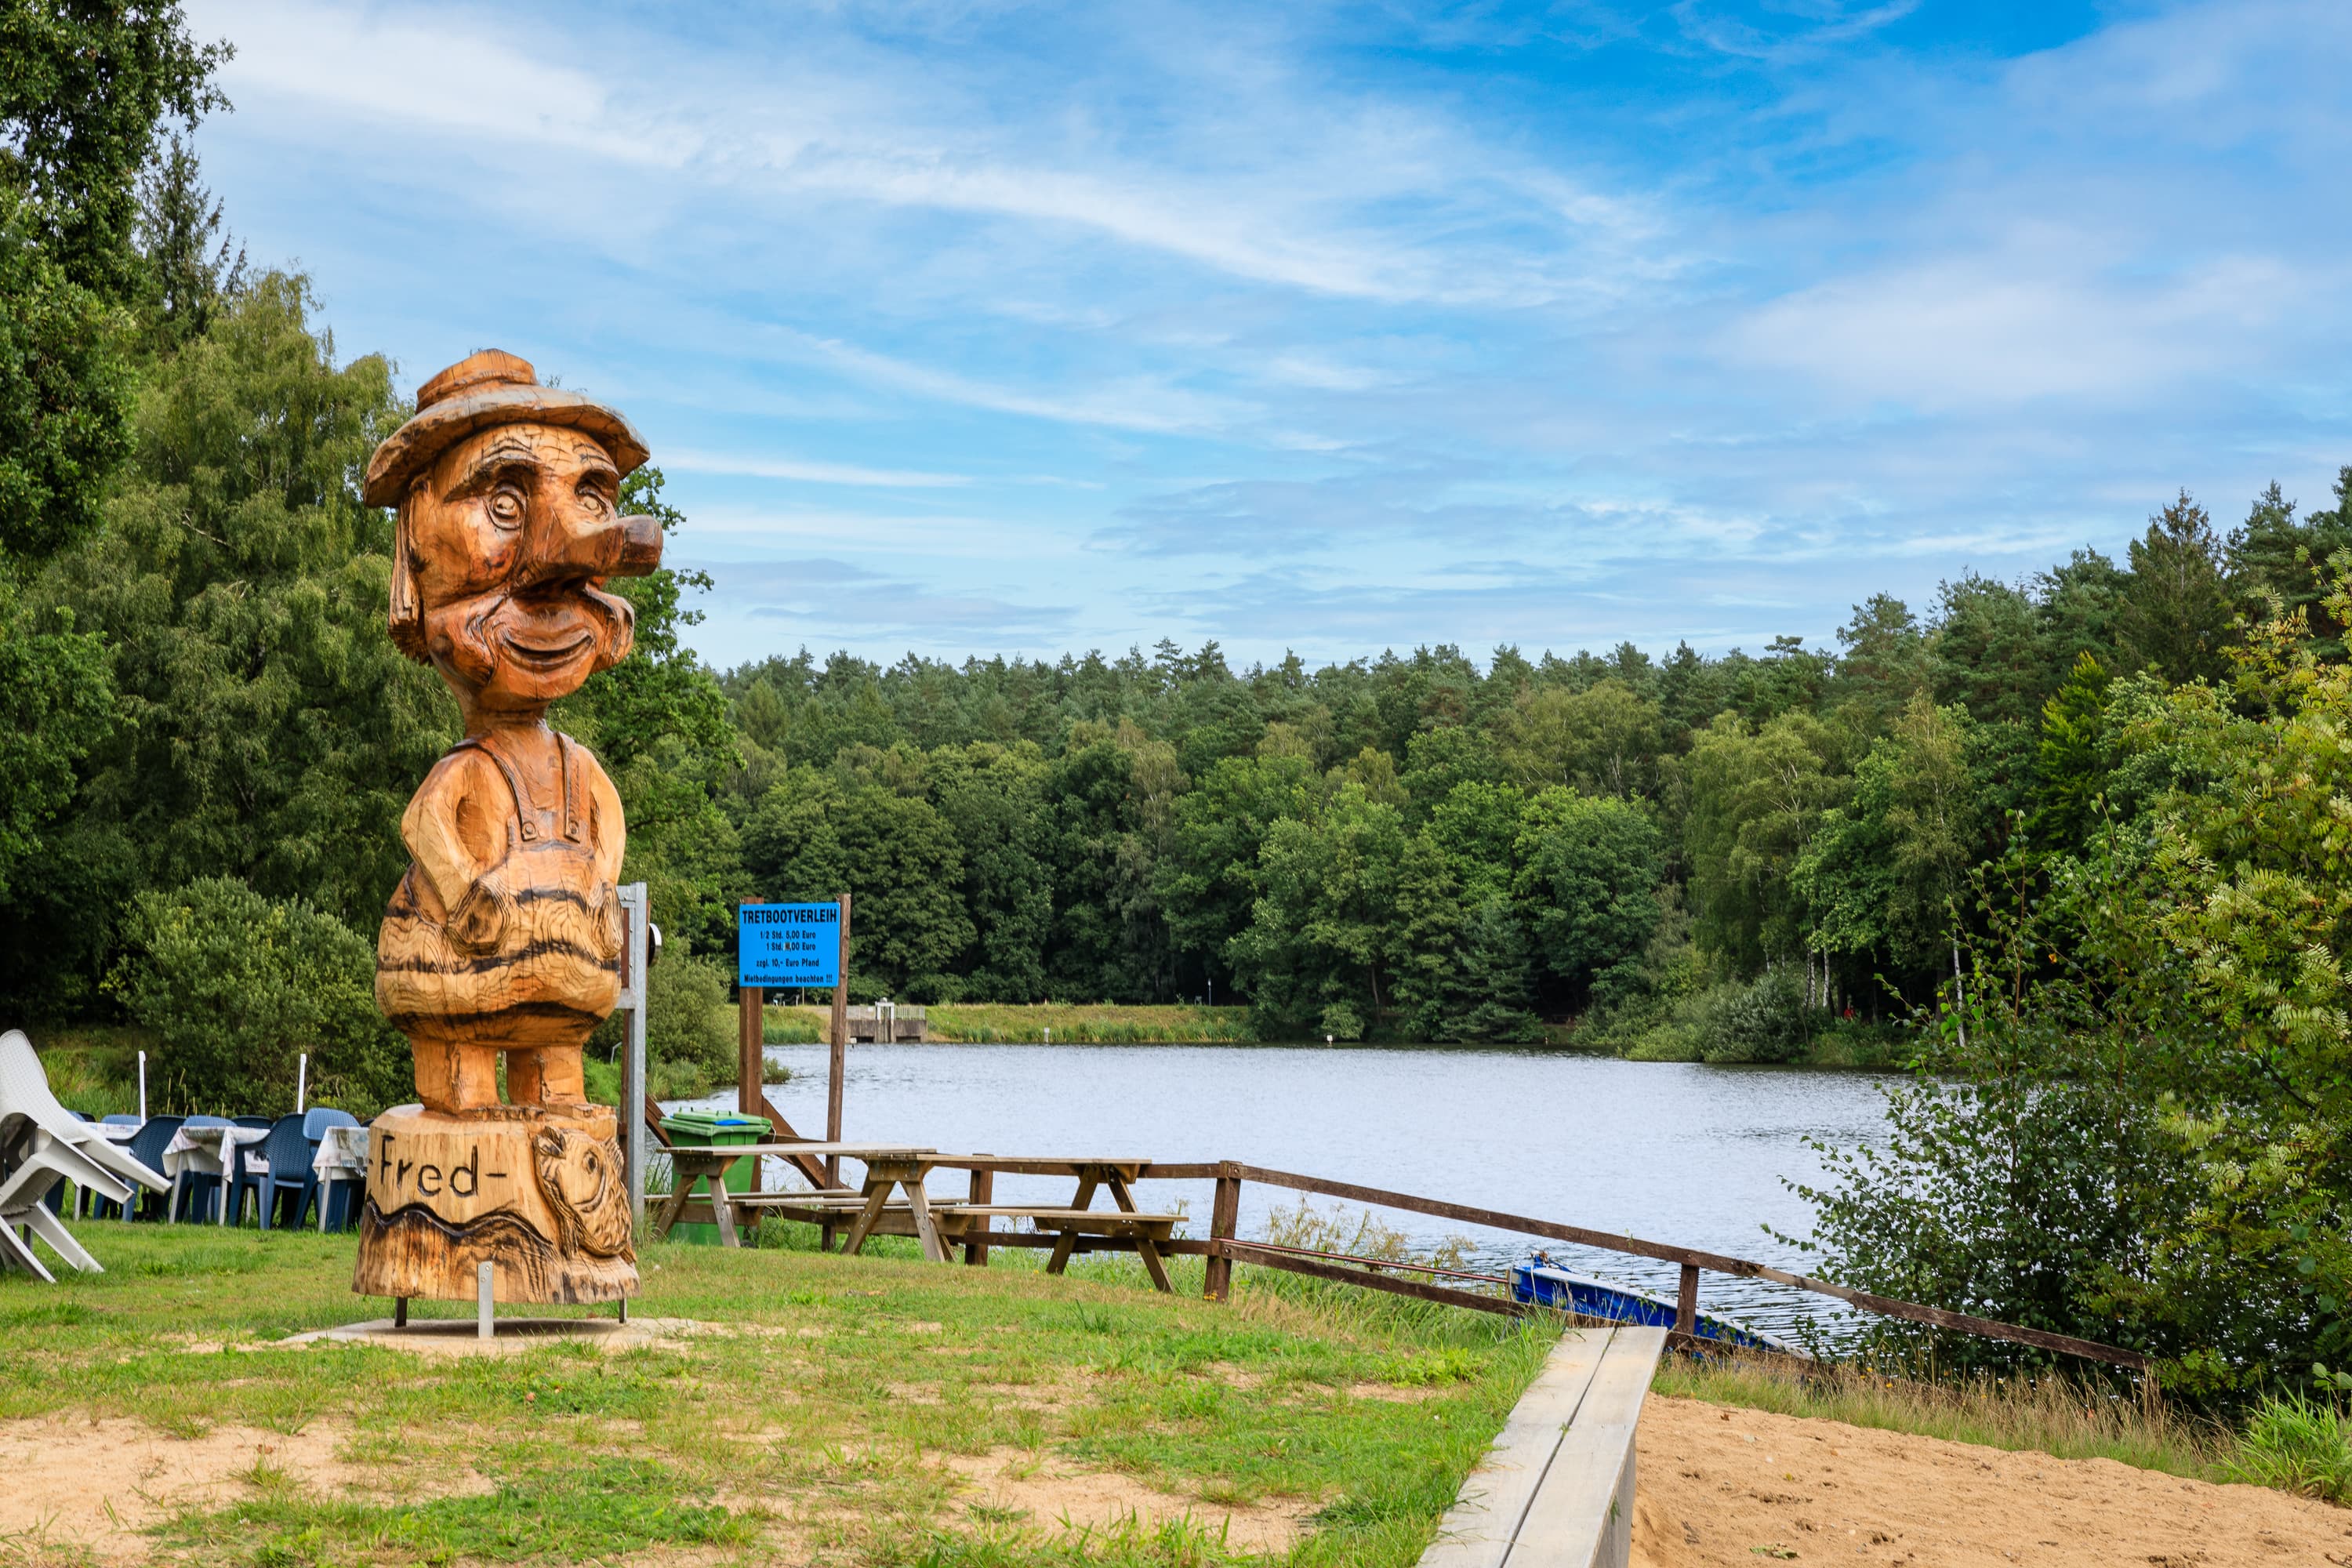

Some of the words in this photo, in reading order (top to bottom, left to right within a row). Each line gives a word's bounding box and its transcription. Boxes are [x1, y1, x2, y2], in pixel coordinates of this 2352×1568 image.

[742, 909, 837, 924] TRETBOOTVERLEIH
[771, 931, 783, 939] Std.
[786, 931, 800, 940] 5,00
[802, 931, 816, 939] Euro
[771, 942, 783, 951] Std.
[802, 942, 816, 951] Euro
[757, 959, 769, 969] zzgl.
[771, 958, 783, 968] 10,-
[786, 958, 799, 967] Euro
[801, 958, 819, 967] Pfand
[744, 975, 793, 984] Mietbedingungen
[795, 975, 824, 983] beachten
